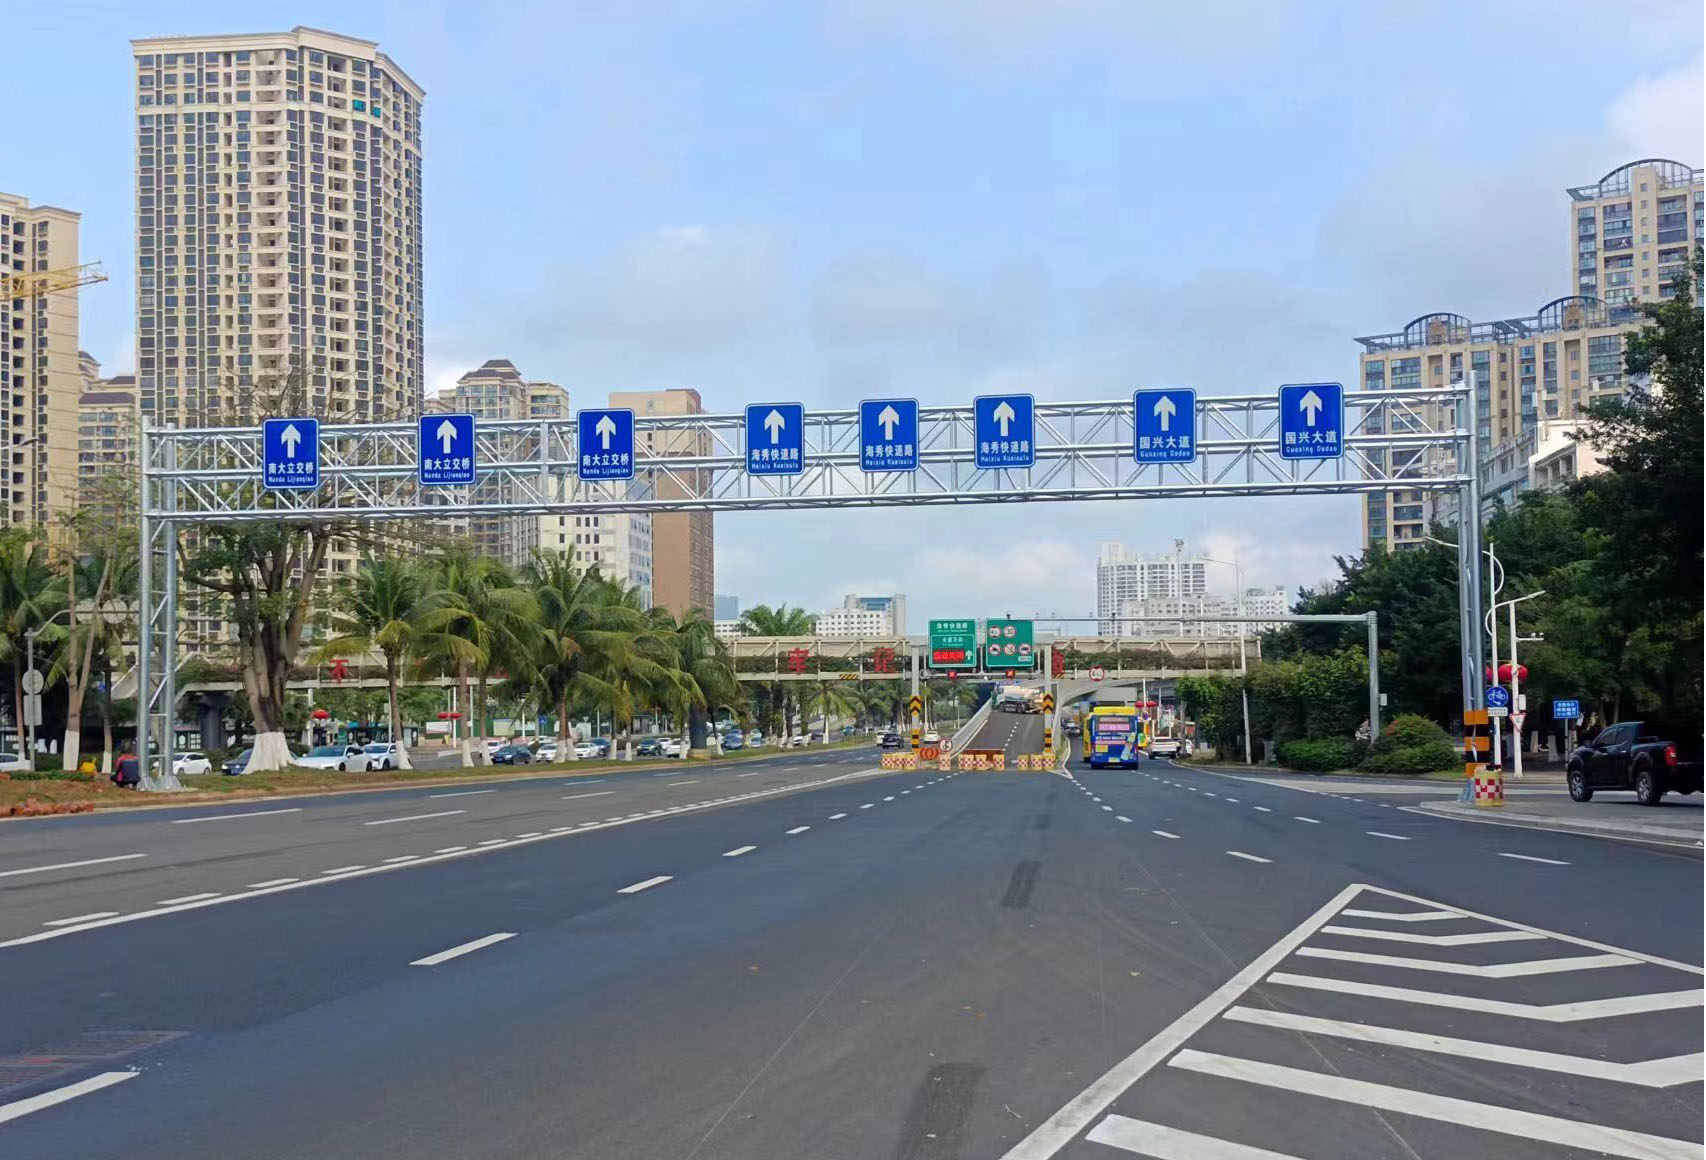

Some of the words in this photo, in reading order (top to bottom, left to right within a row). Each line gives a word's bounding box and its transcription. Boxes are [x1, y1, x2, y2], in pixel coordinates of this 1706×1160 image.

[1139, 436, 1190, 449] 国兴大道
[1286, 430, 1337, 444] 国兴大道
[865, 444, 913, 457] 海秀快速路
[981, 440, 1029, 454] 海秀快速路
[582, 453, 629, 466] 南大立交桥
[752, 448, 798, 461] 海秀快速路
[268, 462, 313, 474] 南大立交桥
[424, 457, 470, 470] 南大立交桥
